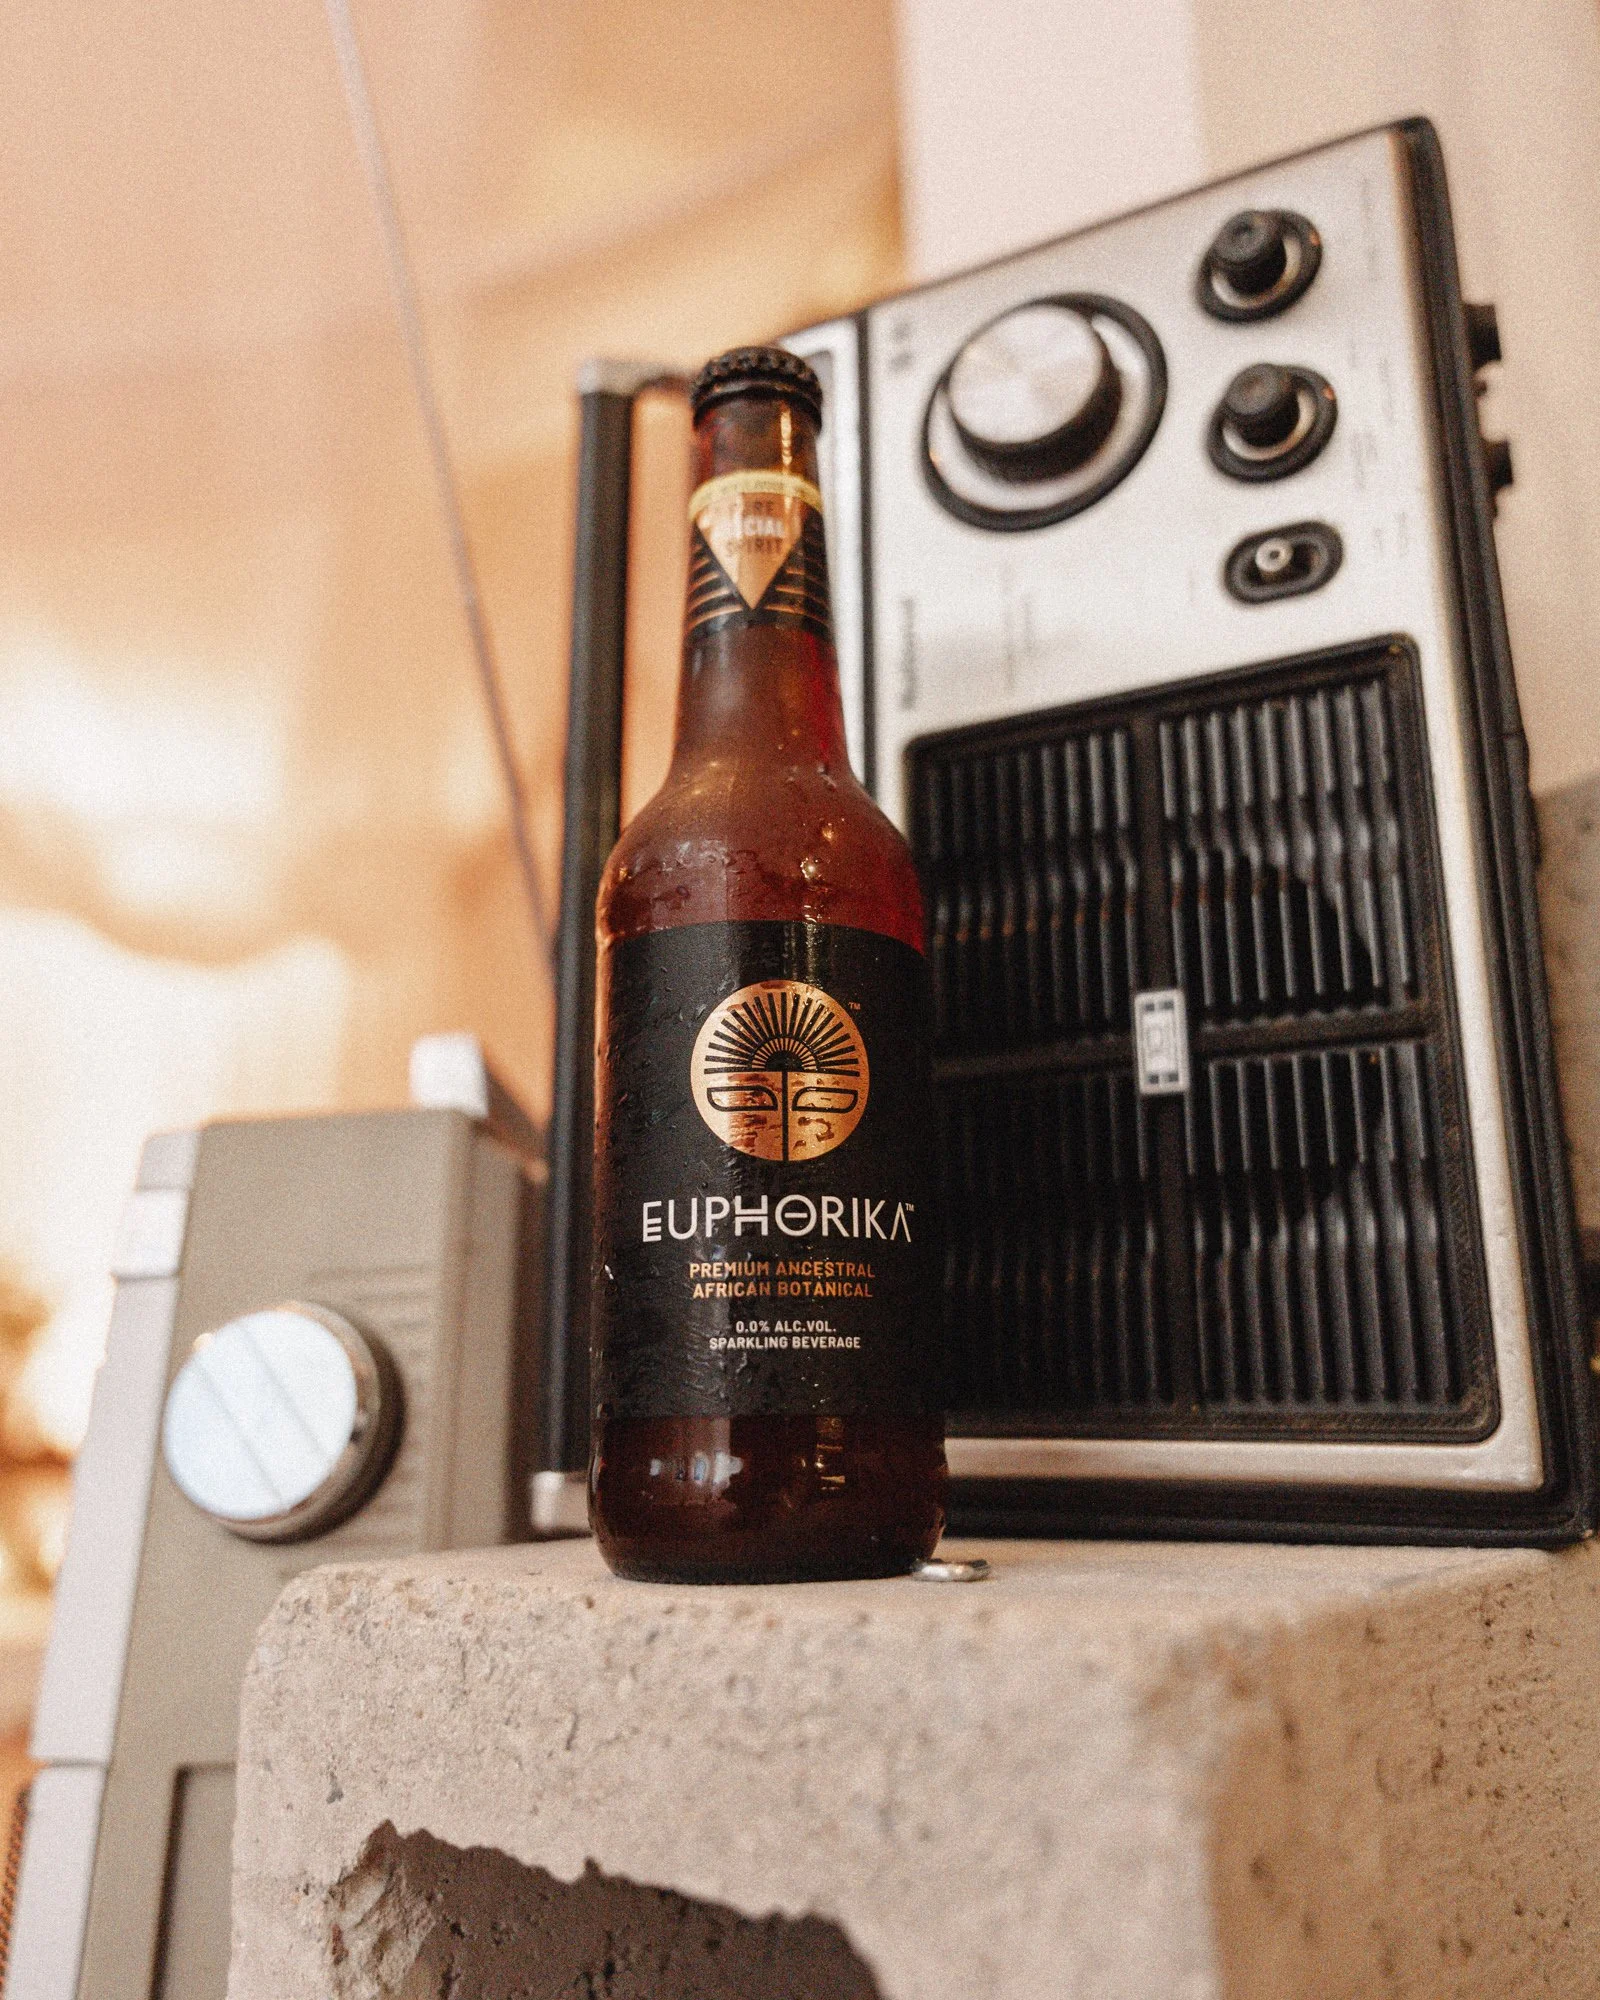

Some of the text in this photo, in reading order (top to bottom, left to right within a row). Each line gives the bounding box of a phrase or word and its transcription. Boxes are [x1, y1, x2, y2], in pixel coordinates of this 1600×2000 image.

[689, 1261, 876, 1279] PREMIUM ANCESTRAL
[692, 1281, 874, 1300] AFRICAN BOTANICAL
[735, 1320, 837, 1334] 0.0% ALC.VOL.
[709, 1336, 861, 1350] SPARKLING BEVERAGE
